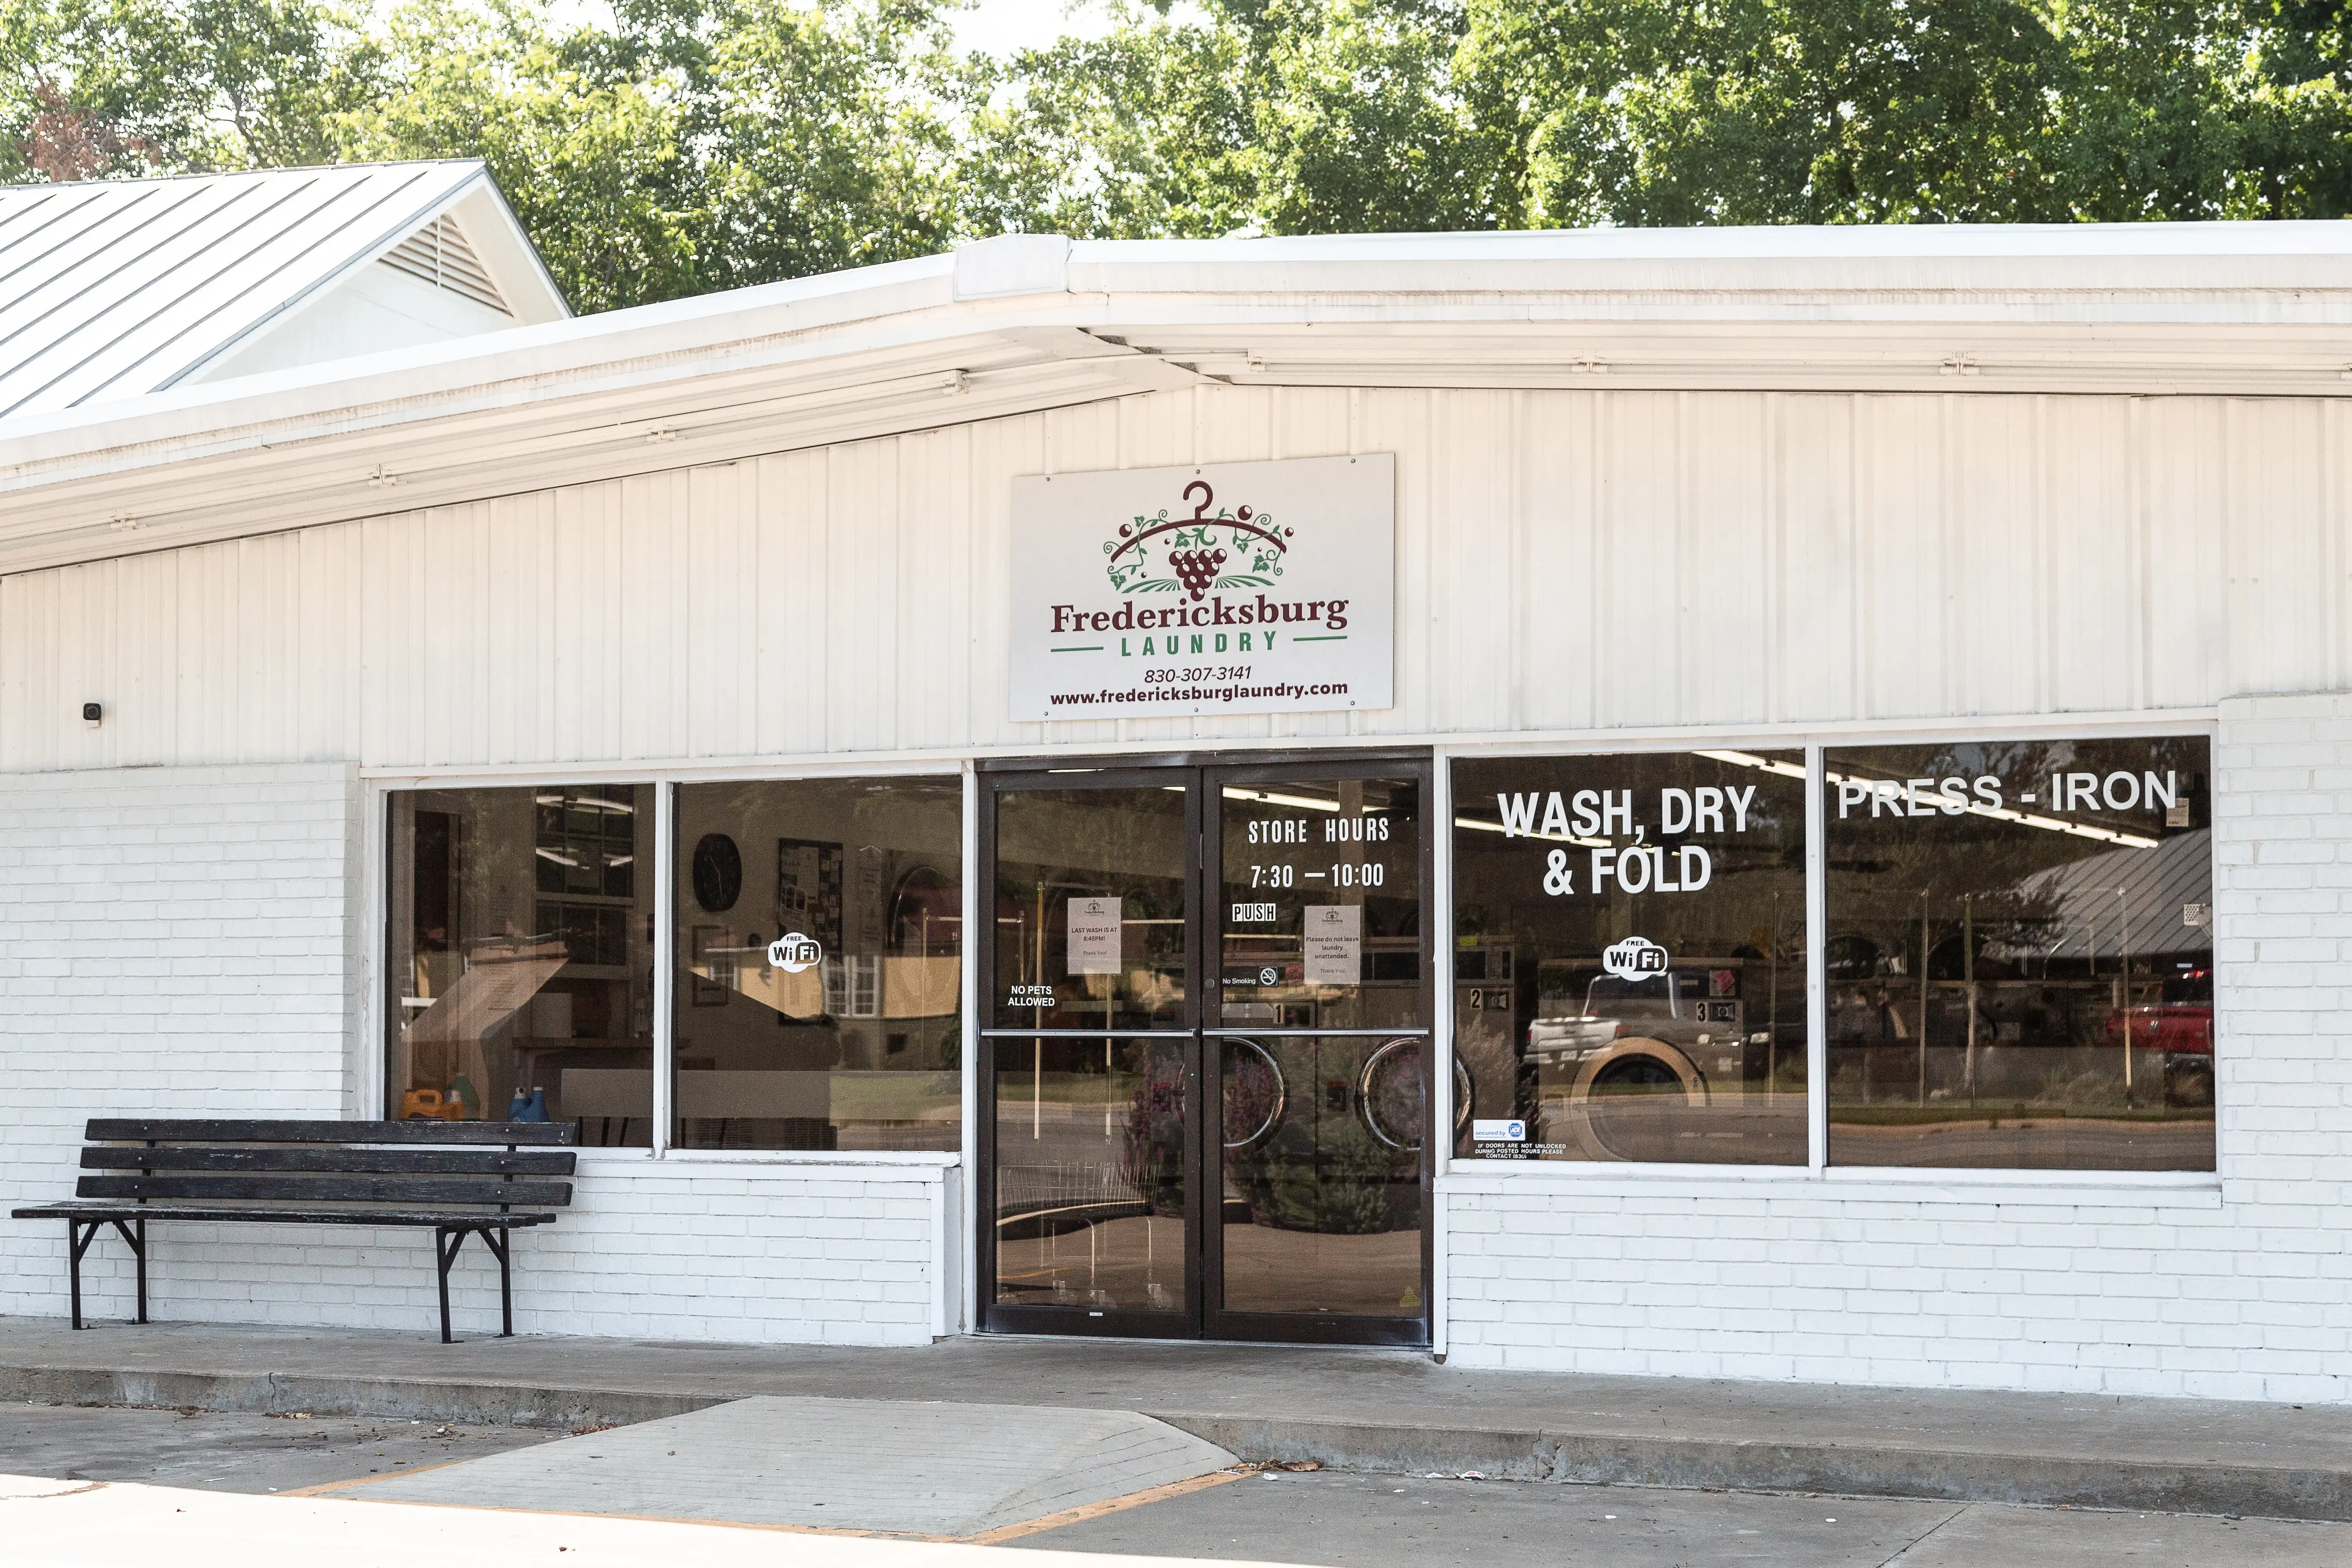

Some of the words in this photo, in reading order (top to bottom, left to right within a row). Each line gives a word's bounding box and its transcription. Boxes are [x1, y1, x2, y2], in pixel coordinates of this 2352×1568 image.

[1051, 594, 1349, 633] Fredericksburg
[1121, 631, 1277, 657] LAUNDRY
[1144, 666, 1252, 683] 830-307-3141
[1051, 682, 1348, 705] www.fredericksburglaundry.com
[1839, 775, 2003, 818] PRESS
[2052, 770, 2176, 811] IRON
[1497, 789, 1645, 845] WASH,
[1662, 785, 1756, 834] DRY
[1248, 820, 1307, 843] STORE
[1325, 817, 1389, 842] HOURS
[1251, 865, 1293, 888] 7:30
[1332, 863, 1384, 887] 10:00
[1543, 848, 1575, 896] &
[1592, 845, 1711, 894] FOLD
[1234, 904, 1274, 920] PUSH
[1007, 997, 1055, 1006] ALLOWED
[1011, 985, 1026, 995] NO
[1028, 985, 1052, 995] PETS
[1472, 989, 1480, 1009] 2
[1276, 1004, 1281, 1023] 1
[1697, 1002, 1706, 1022] 3
